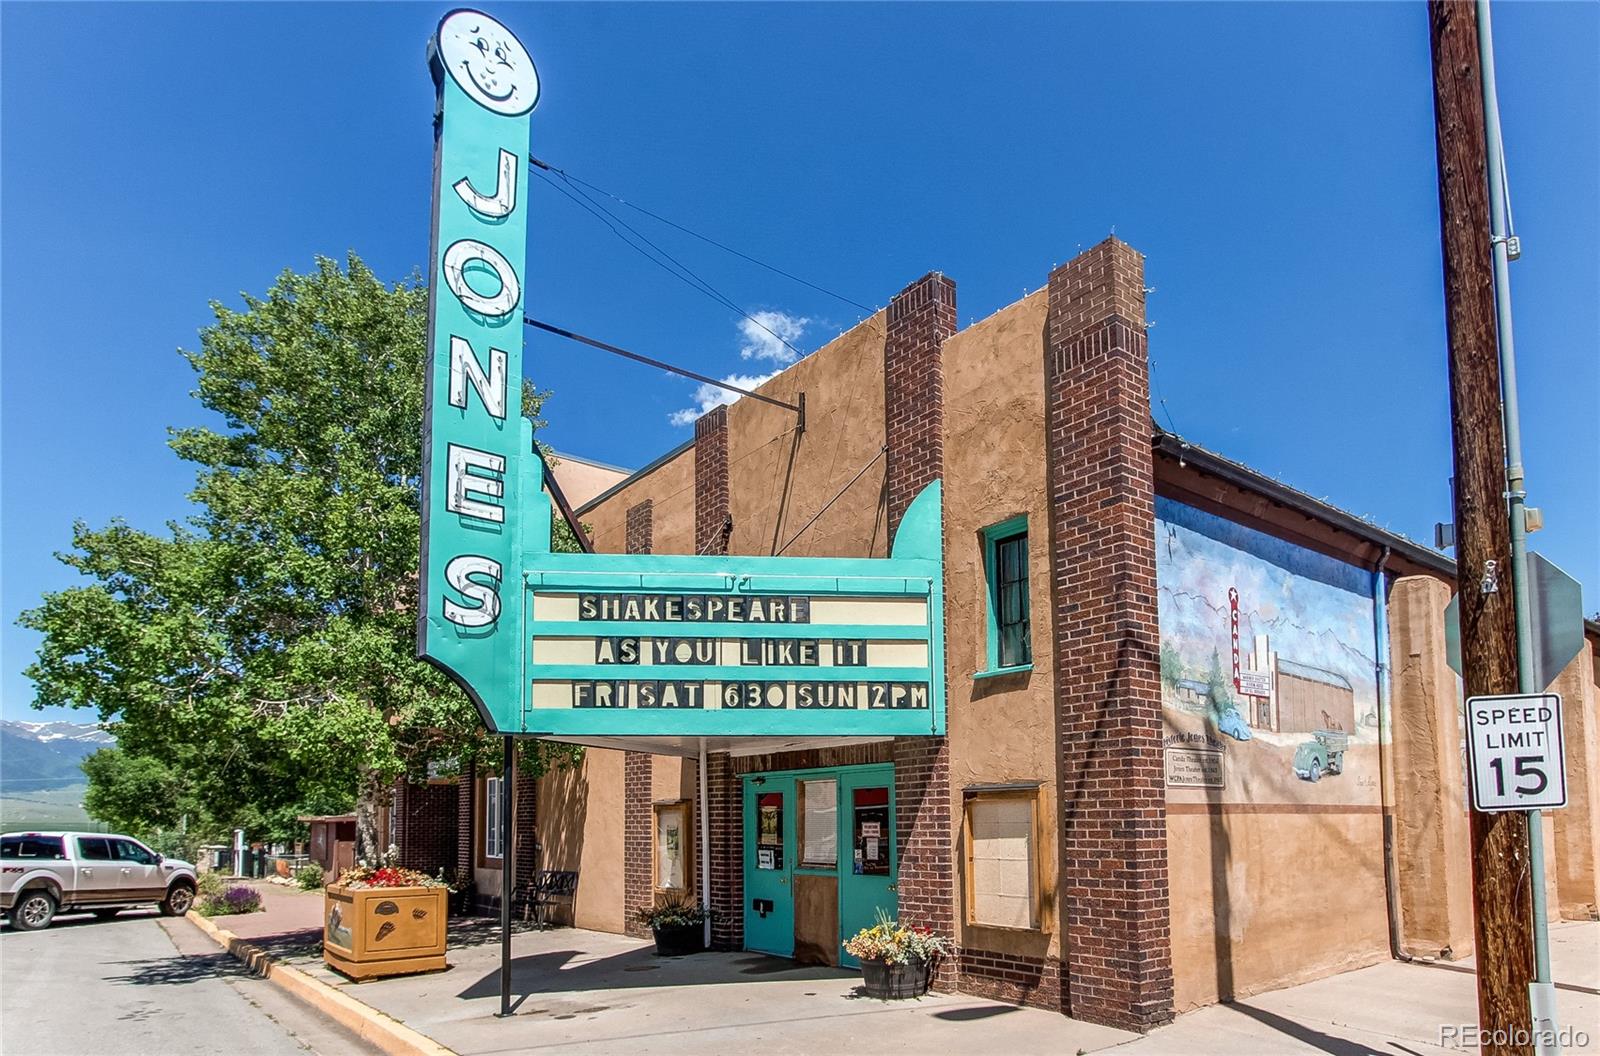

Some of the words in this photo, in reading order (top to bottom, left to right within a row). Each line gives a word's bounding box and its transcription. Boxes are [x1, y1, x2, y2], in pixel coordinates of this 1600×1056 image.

[442, 147, 521, 629] JONES
[579, 594, 810, 622] SHAKESPEARE
[597, 638, 638, 663] AS
[655, 639, 713, 664] YOU
[742, 640, 816, 665] LIKE
[836, 641, 863, 665] IT
[574, 682, 625, 707] FRI
[640, 682, 701, 707] SAT
[724, 682, 784, 708] 630
[798, 683, 854, 708] SUN
[871, 683, 928, 708] 2PM
[1476, 707, 1552, 726] SPEED
[1486, 731, 1545, 749] LIMIT
[1489, 755, 1548, 796] 15
